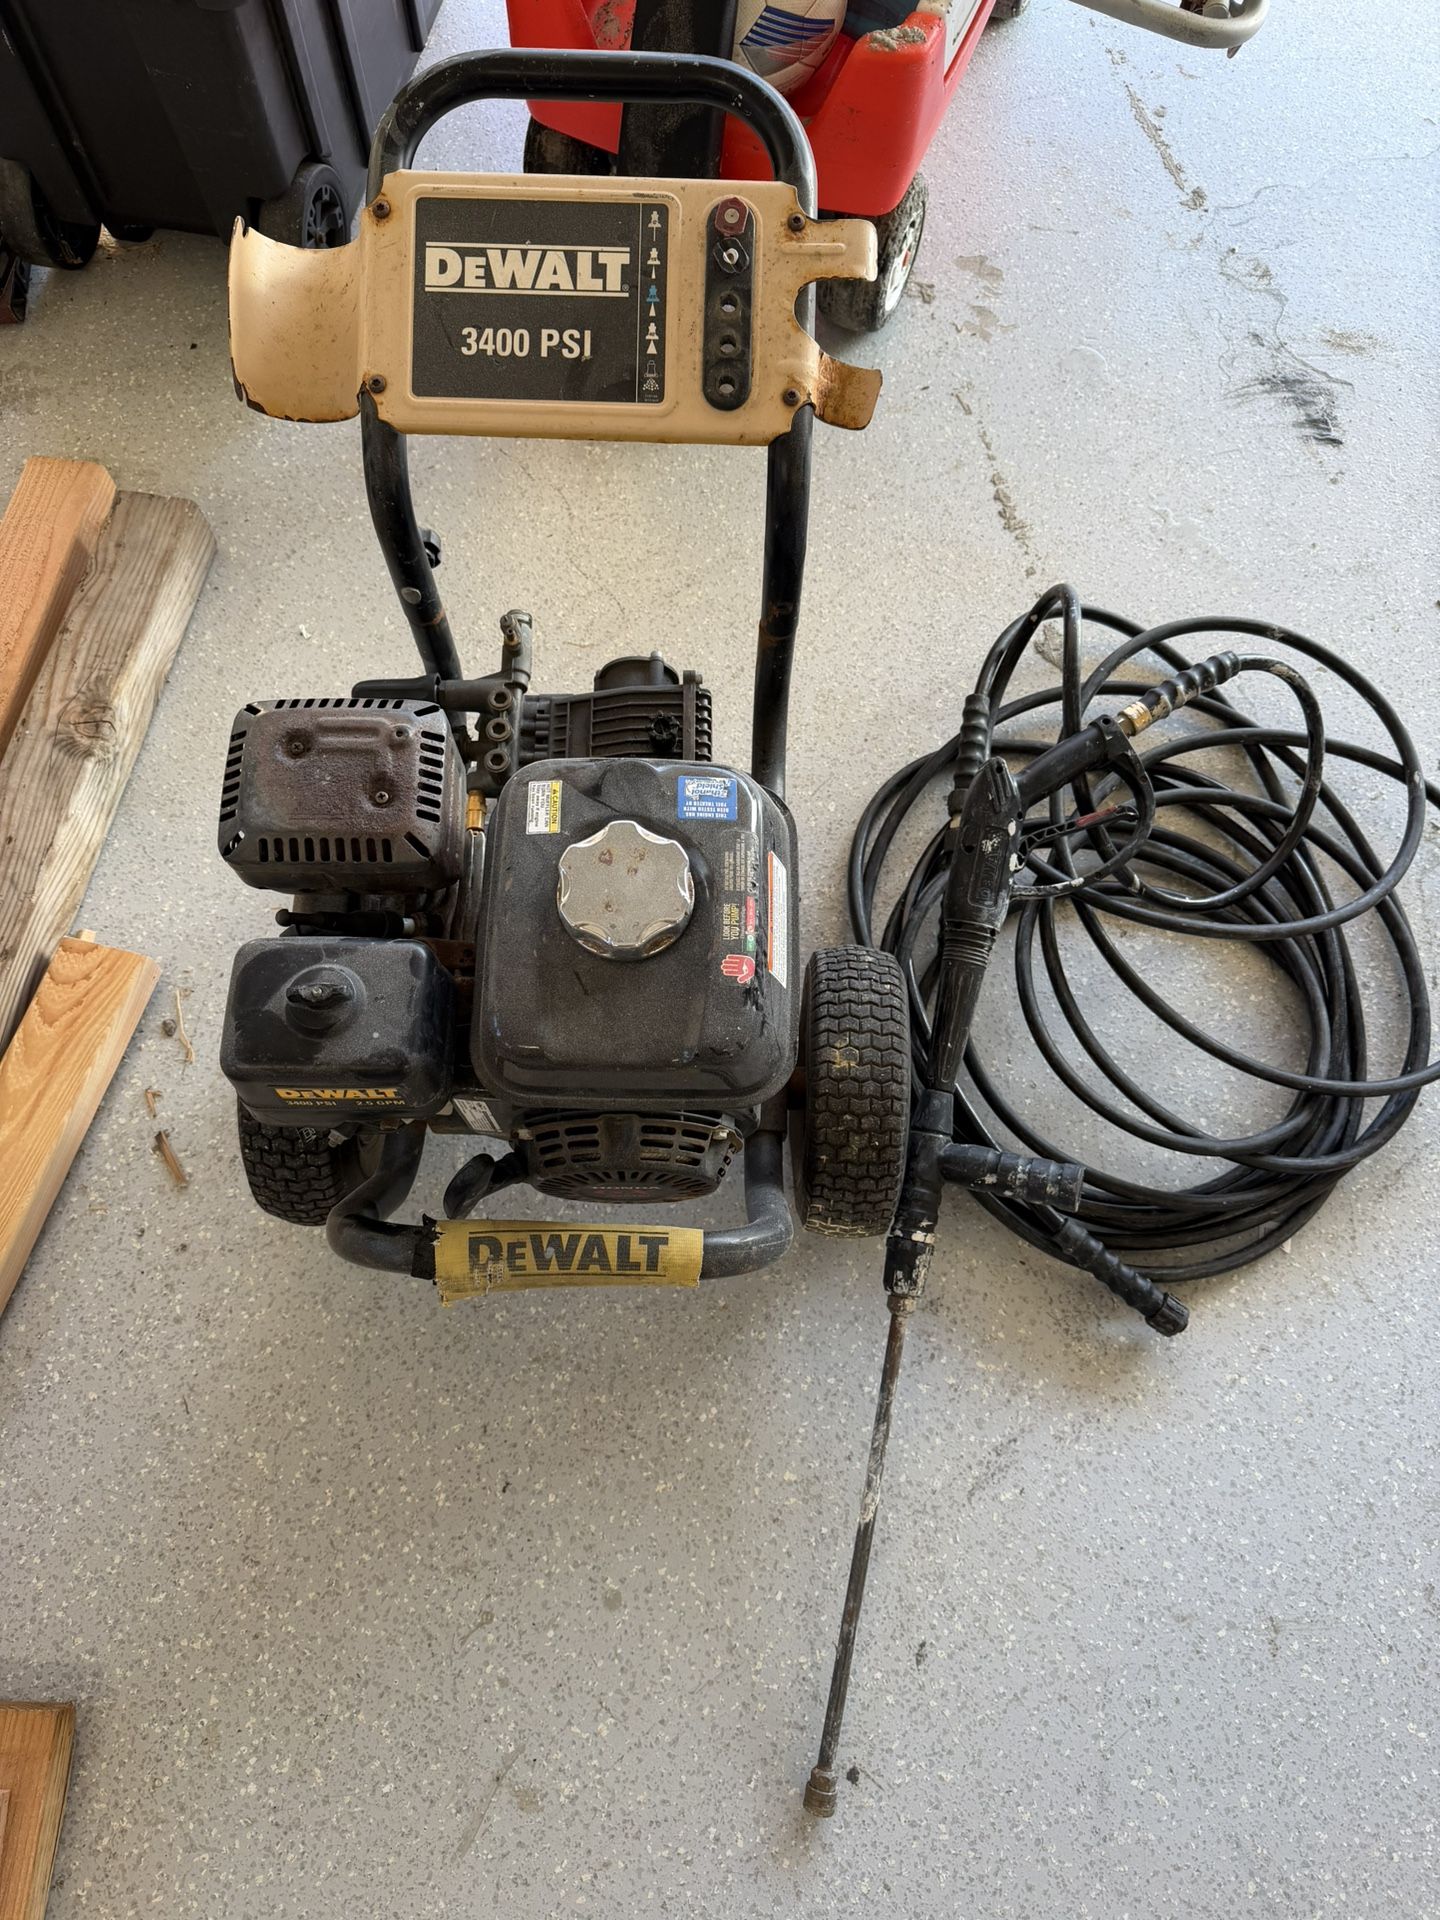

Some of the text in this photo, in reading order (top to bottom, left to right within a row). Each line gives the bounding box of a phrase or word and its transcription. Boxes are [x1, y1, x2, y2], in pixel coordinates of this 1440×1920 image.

[461, 327, 592, 359] 3400 PSI
[722, 903, 731, 940] LOOK BEFORE
[730, 903, 739, 940] YOU PUMP!
